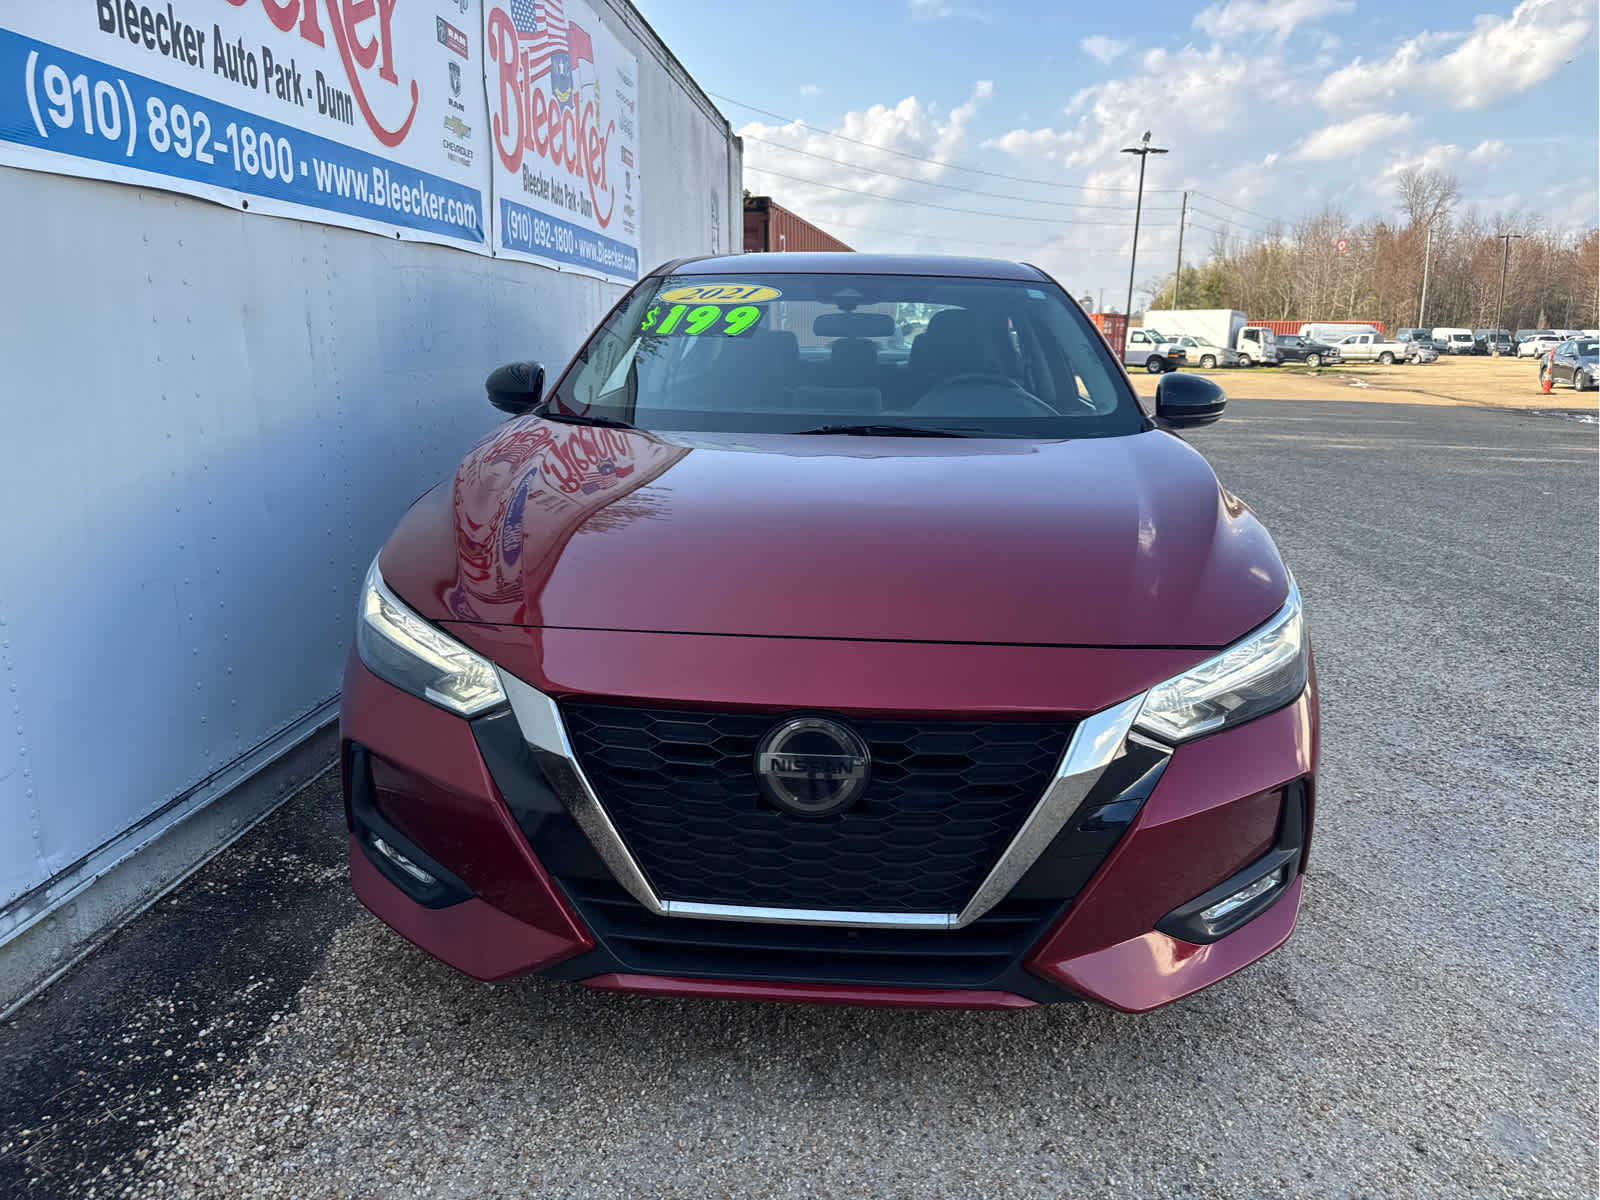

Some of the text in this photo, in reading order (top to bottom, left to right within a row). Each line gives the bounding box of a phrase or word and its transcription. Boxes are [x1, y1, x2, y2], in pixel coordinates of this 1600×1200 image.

[96, 0, 205, 69] Bleecker
[213, 23, 258, 90] Auto
[261, 45, 304, 107] Park
[315, 69, 354, 127] Dunn
[25, 50, 136, 157] (910)
[146, 96, 294, 184] 892-1800
[312, 157, 478, 230] www.Bleecker.com
[487, 7, 616, 229] Bleecker
[506, 205, 533, 249] (910)
[533, 216, 574, 255] 892-1800
[677, 287, 762, 301] 2021
[641, 304, 761, 336] $199
[769, 757, 855, 776] NISSAN
